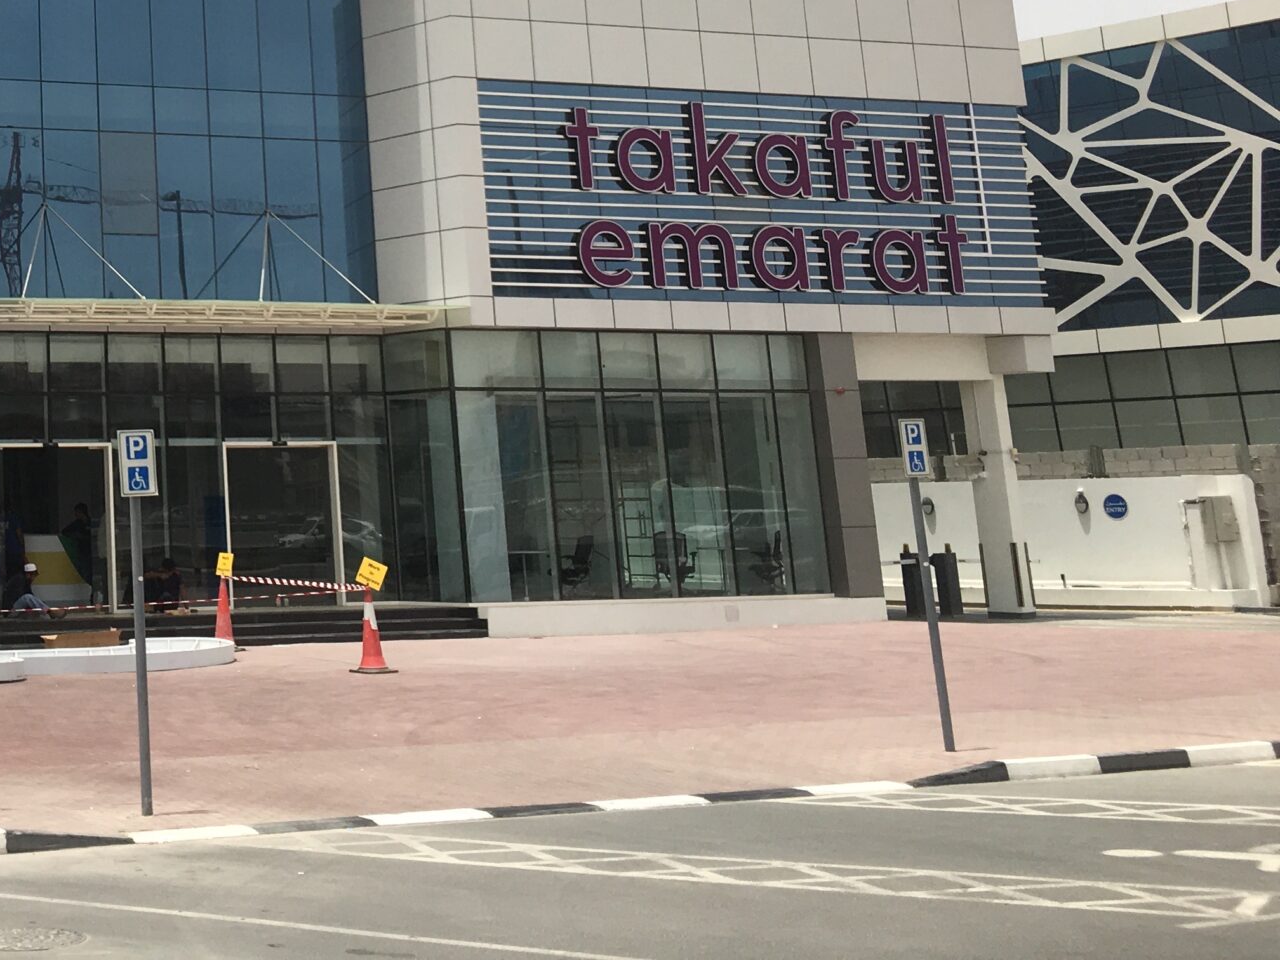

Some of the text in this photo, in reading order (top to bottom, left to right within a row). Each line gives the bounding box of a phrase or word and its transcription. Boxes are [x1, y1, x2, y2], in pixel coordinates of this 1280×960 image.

[565, 102, 956, 205] takaful
[577, 214, 969, 296] emarat
[128, 436, 144, 459] P
[906, 424, 919, 445] P
